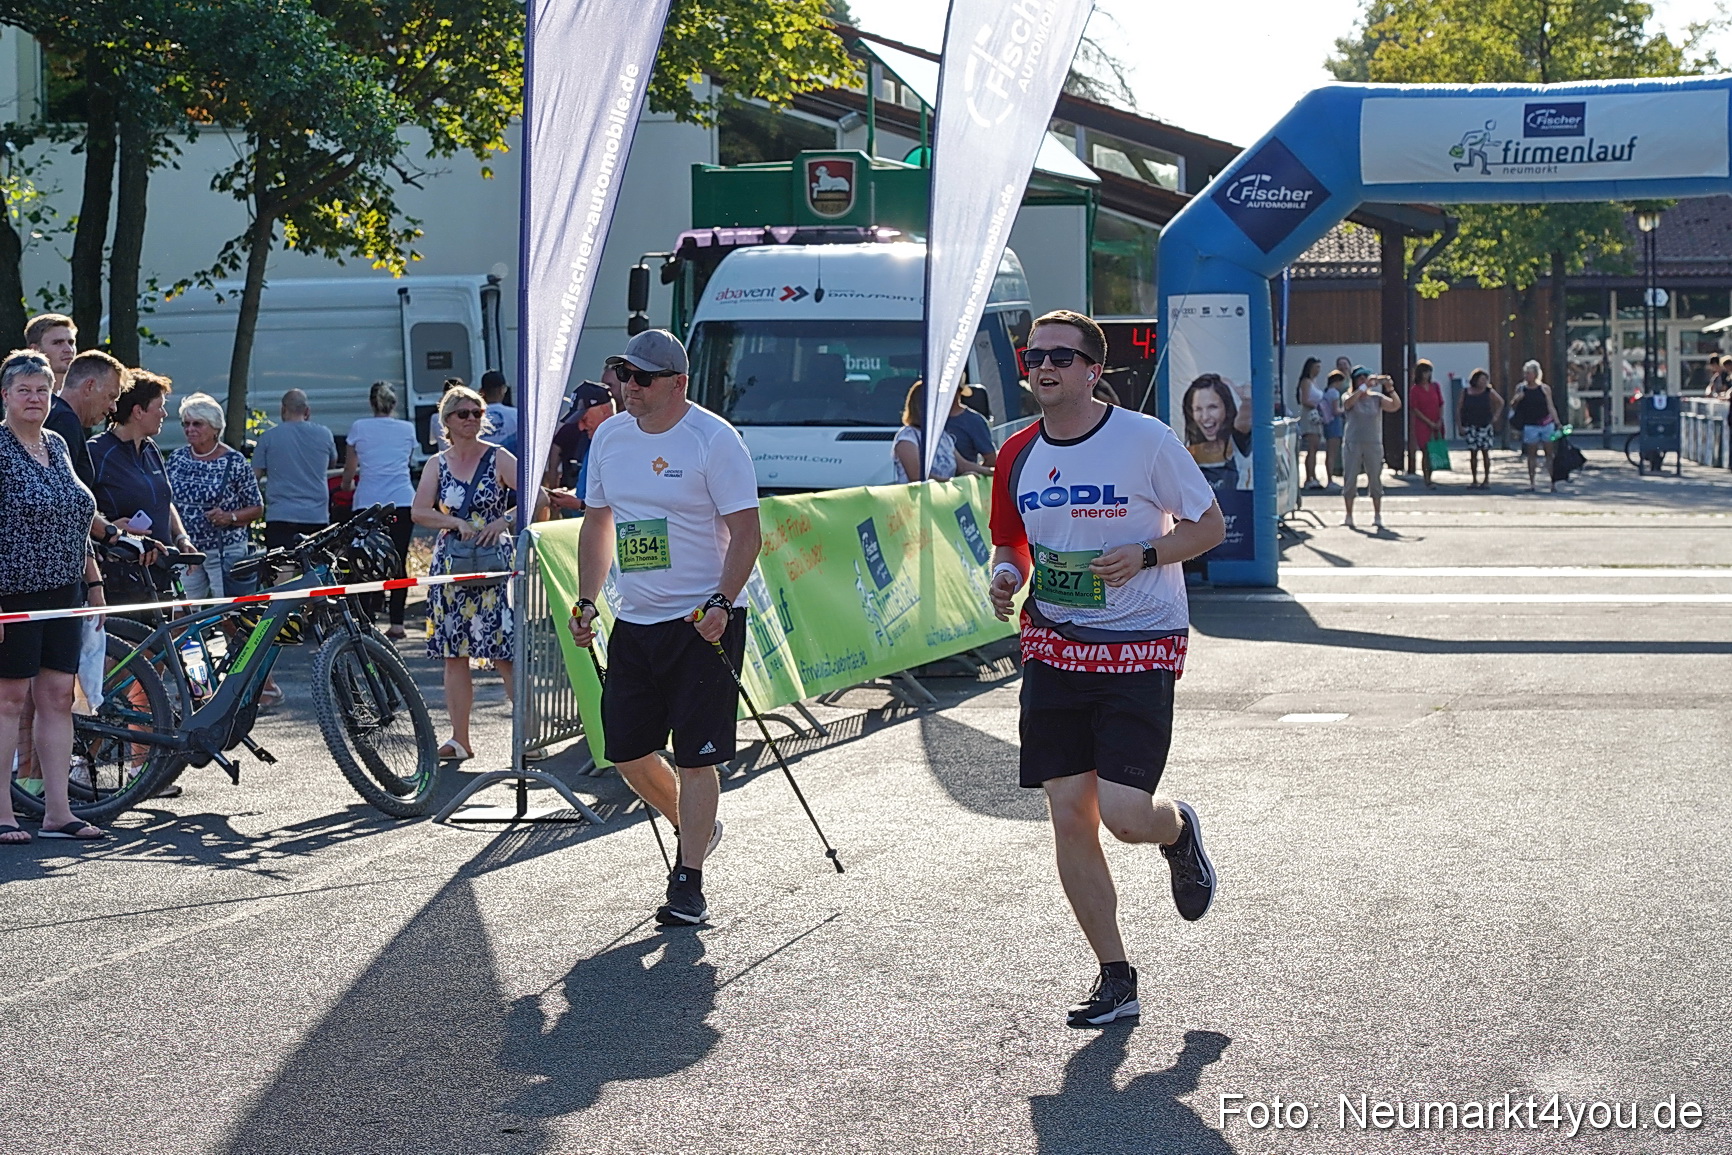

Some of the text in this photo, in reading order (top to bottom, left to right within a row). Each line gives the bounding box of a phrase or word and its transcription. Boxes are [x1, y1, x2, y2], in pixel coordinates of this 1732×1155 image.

[1536, 115, 1582, 125] Fischer
[1502, 136, 1638, 165] firmenlauf
[1503, 166, 1558, 175] neumarkt
[1241, 186, 1313, 201] Fischer
[1246, 201, 1307, 209] AUTOMOBILE
[548, 63, 640, 372] www.fischer-automobile.de
[715, 286, 776, 301] abavent
[938, 183, 1016, 393] www.fischer-automobile.de
[1071, 501, 1127, 518] energie
[623, 537, 659, 555] 1354
[1047, 568, 1083, 590] 327
[1093, 574, 1102, 601] 2022
[1062, 644, 1113, 661] AVIA
[1119, 641, 1173, 661] AVIA
